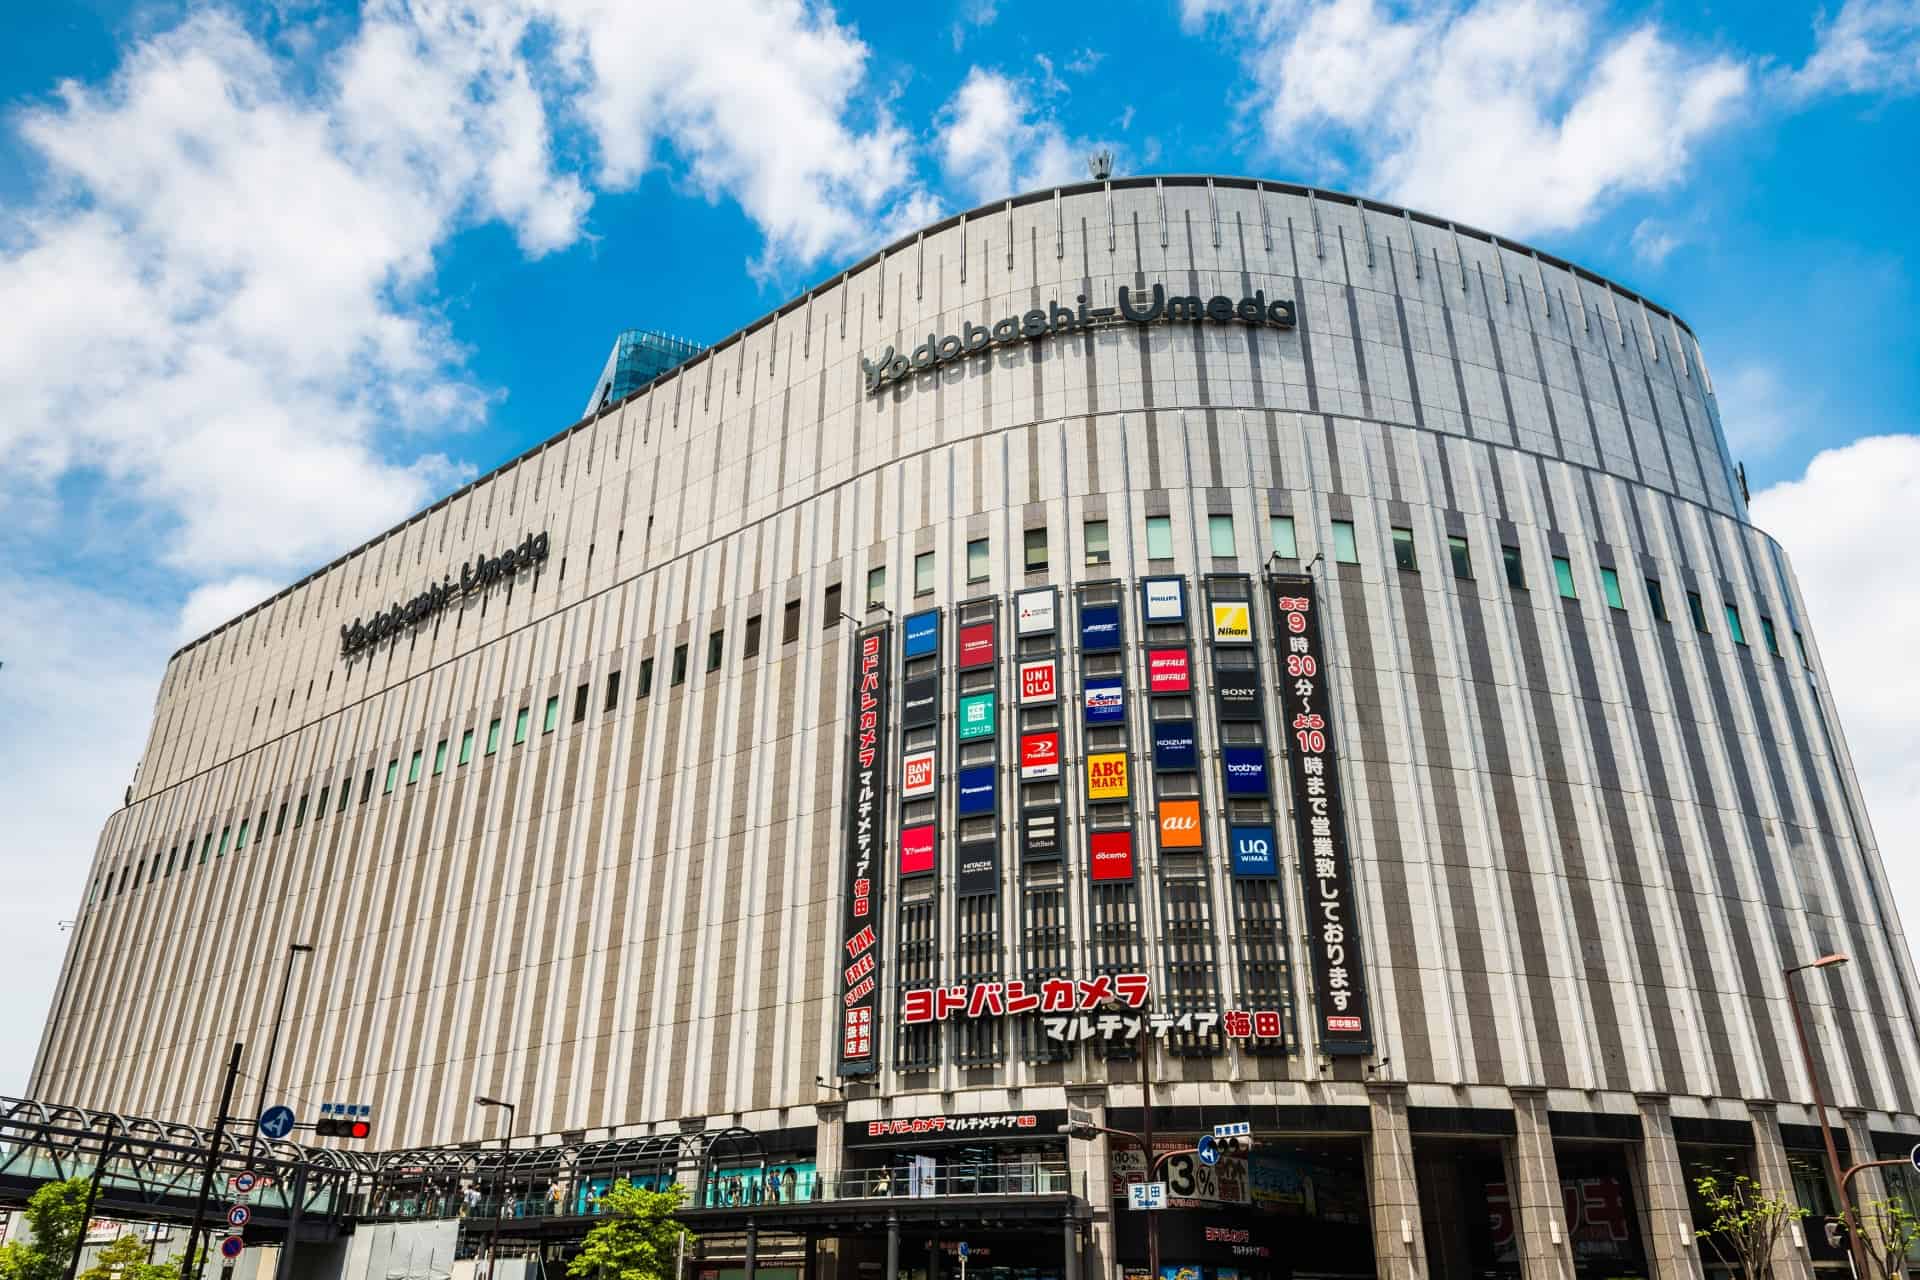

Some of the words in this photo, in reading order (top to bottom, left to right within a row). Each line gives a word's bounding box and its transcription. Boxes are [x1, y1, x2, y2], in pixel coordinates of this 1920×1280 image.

[863, 283, 1297, 390] Yodobashi-Umeda
[340, 531, 550, 656] Yodobashi-Umeda
[1217, 627, 1249, 636] Nikon
[1026, 670, 1048, 682] UNI
[1026, 682, 1051, 694] QLO
[1221, 688, 1256, 696] SONY
[908, 761, 930, 774] BAN
[1091, 761, 1124, 778] ABC
[1228, 764, 1263, 772] brother
[908, 773, 926, 785] DAI
[1091, 777, 1124, 788] MART
[1163, 816, 1197, 831] au
[1240, 839, 1268, 854] UQ
[963, 860, 991, 869] HITACHI
[846, 924, 876, 958] TAX
[844, 952, 875, 985] FREE
[844, 976, 875, 1006] STORE
[904, 975, 1149, 1024] ヨドバシカメラ
